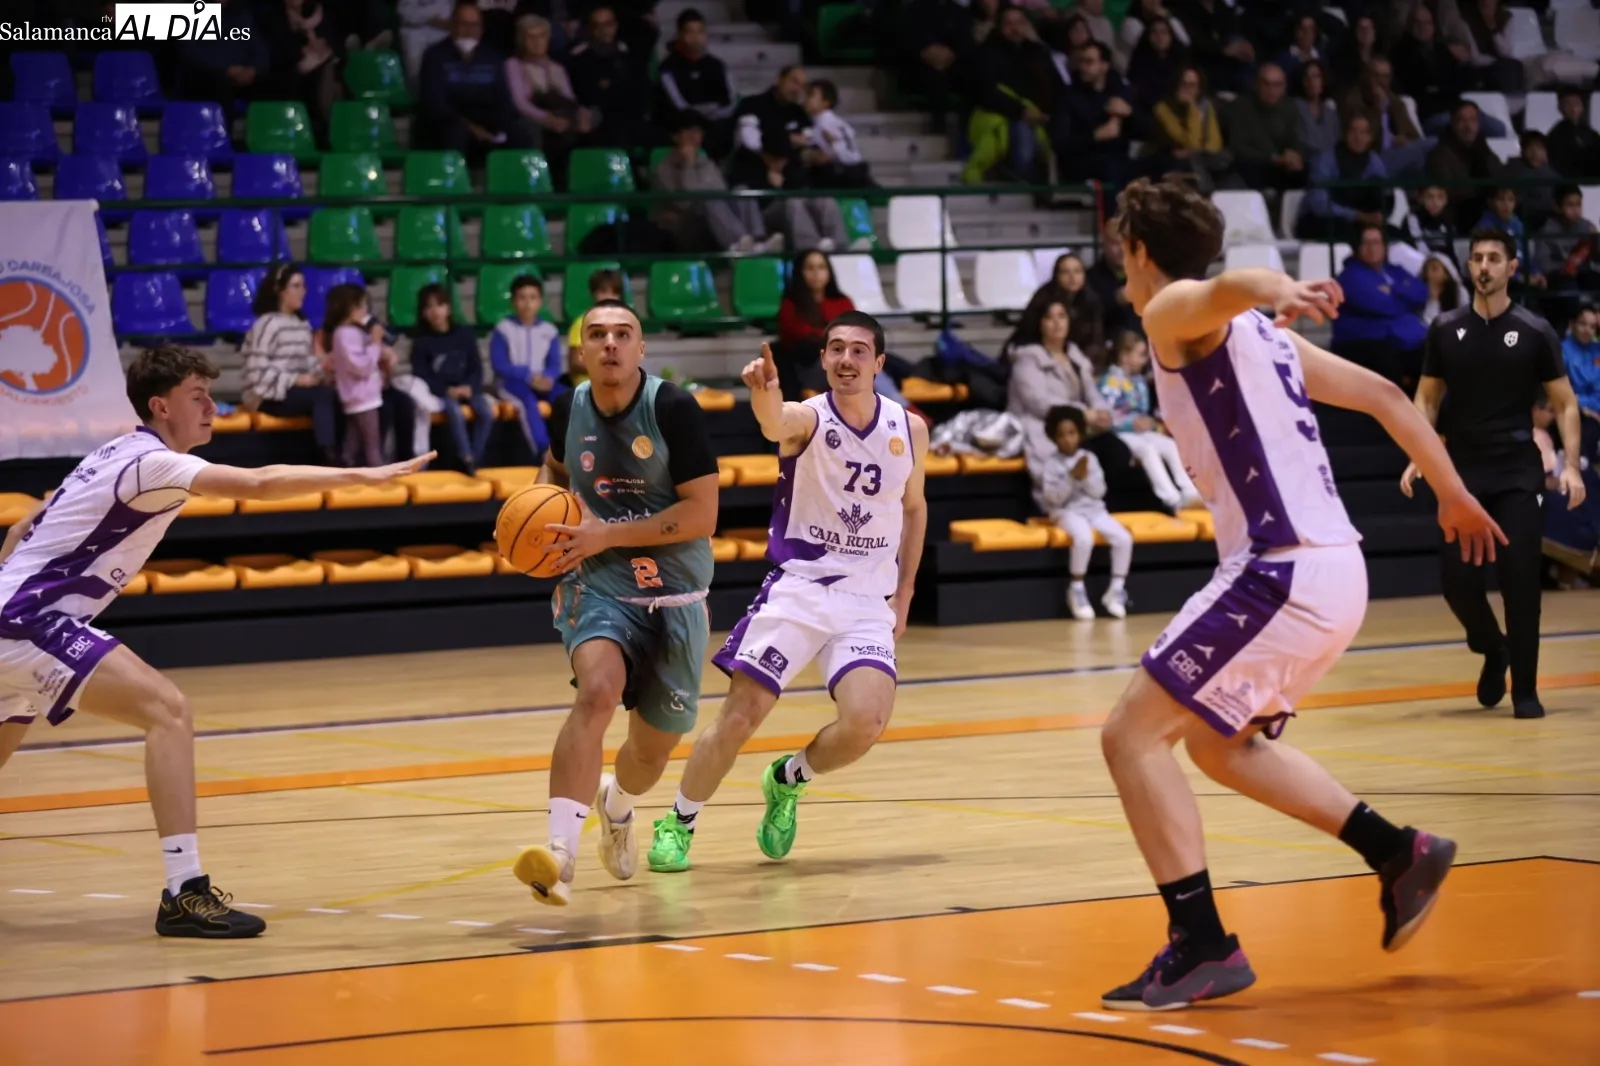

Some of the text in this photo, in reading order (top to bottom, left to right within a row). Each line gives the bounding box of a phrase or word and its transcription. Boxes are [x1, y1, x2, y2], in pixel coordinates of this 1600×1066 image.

[7, 260, 96, 316] CARBAJOSA
[843, 461, 882, 496] 73
[809, 525, 889, 549] CAJA RURAL
[827, 544, 869, 557] DE ZAMORA
[630, 556, 664, 589] 2
[66, 635, 91, 659] CBC
[850, 645, 893, 660] IVECO
[1170, 649, 1204, 681] CBC
